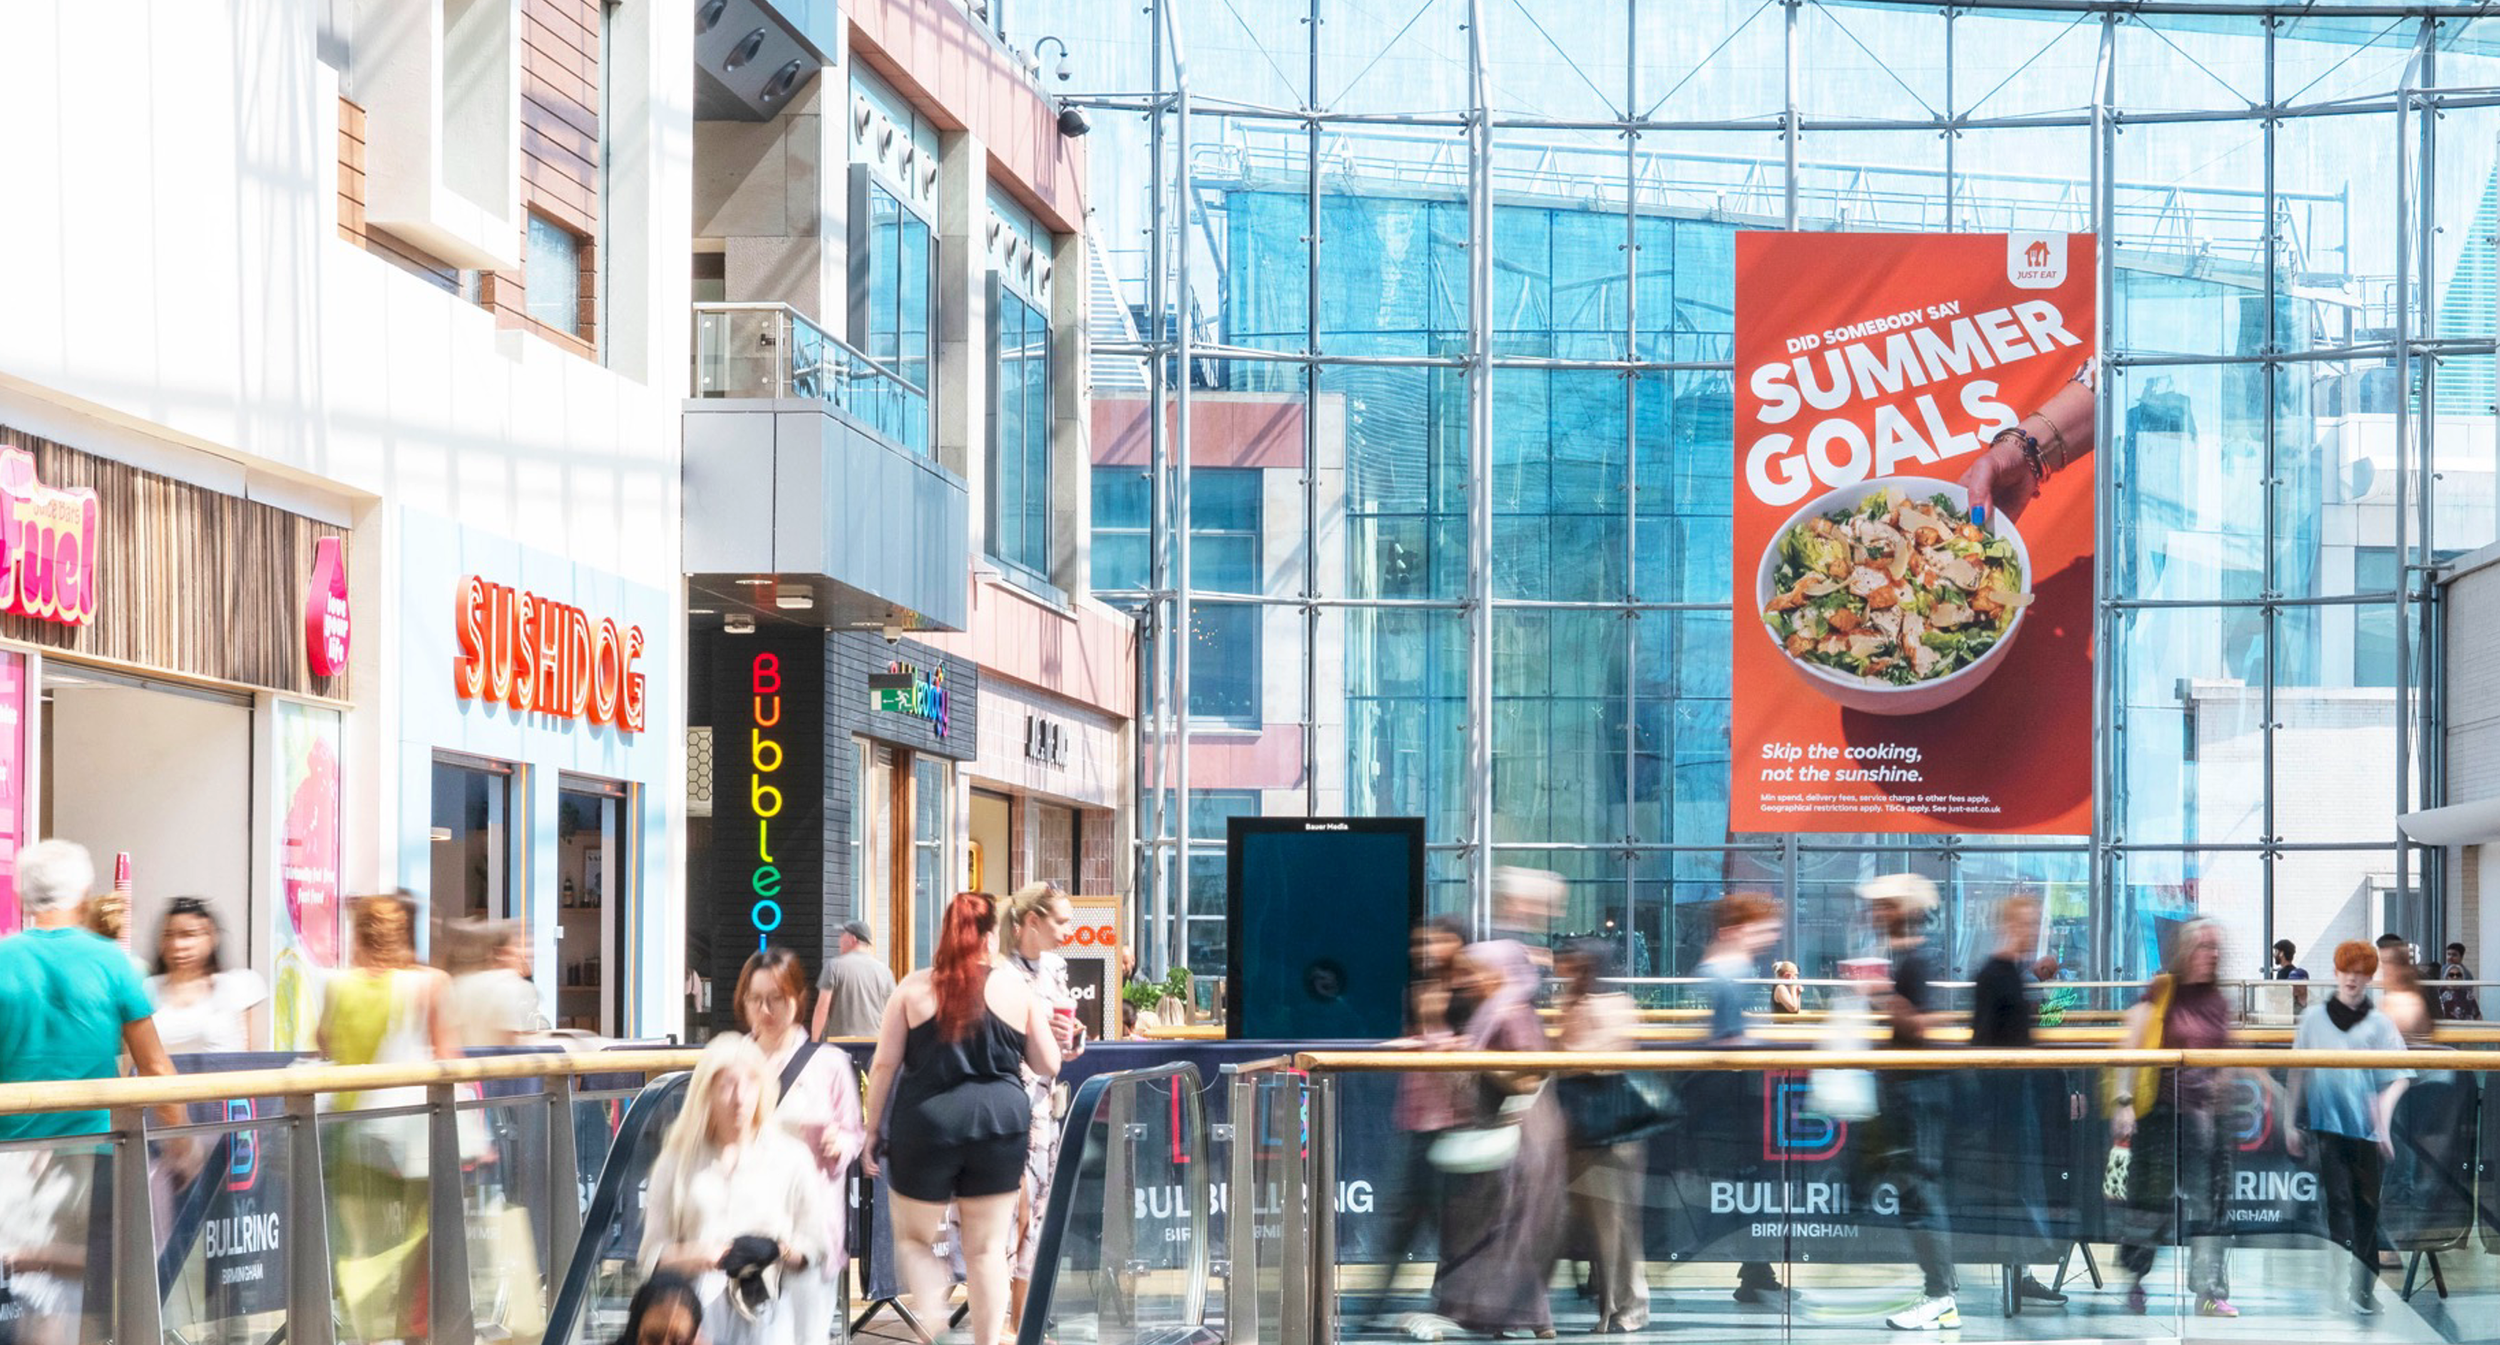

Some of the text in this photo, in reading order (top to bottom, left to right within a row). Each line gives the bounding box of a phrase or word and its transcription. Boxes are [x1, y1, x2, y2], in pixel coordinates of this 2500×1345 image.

[2017, 270, 2057, 280] JUST EAT
[1786, 300, 1961, 354] DID SOMEBODY SAY
[1750, 299, 2083, 424] SUMMER
[1745, 379, 2020, 506] GOALS
[453, 575, 646, 733] SUSHIDOG
[1761, 742, 1922, 764] Skip the cooking,
[1760, 764, 1923, 782] not the sunshine.
[751, 652, 783, 954] Bubbleo
[1760, 804, 1812, 813] Geographical
[1813, 804, 1858, 812] restrictions
[1860, 804, 1883, 813] apply.
[1907, 804, 1931, 813] apply.
[1948, 804, 2001, 813] just-eat.co.uk
[1777, 794, 1804, 802] spend,
[1806, 794, 1837, 803] delivery
[1839, 793, 1858, 802] fees,
[1859, 794, 1887, 802] service
[1889, 794, 1915, 803] charge
[1917, 794, 1923, 802] &
[1925, 794, 1947, 802] other
[1949, 794, 1965, 802] fees
[1967, 795, 1991, 804] apply.
[1305, 823, 1349, 831] Bauer Media
[2234, 1170, 2318, 1202] RING
[206, 1212, 280, 1259] BULLRING
